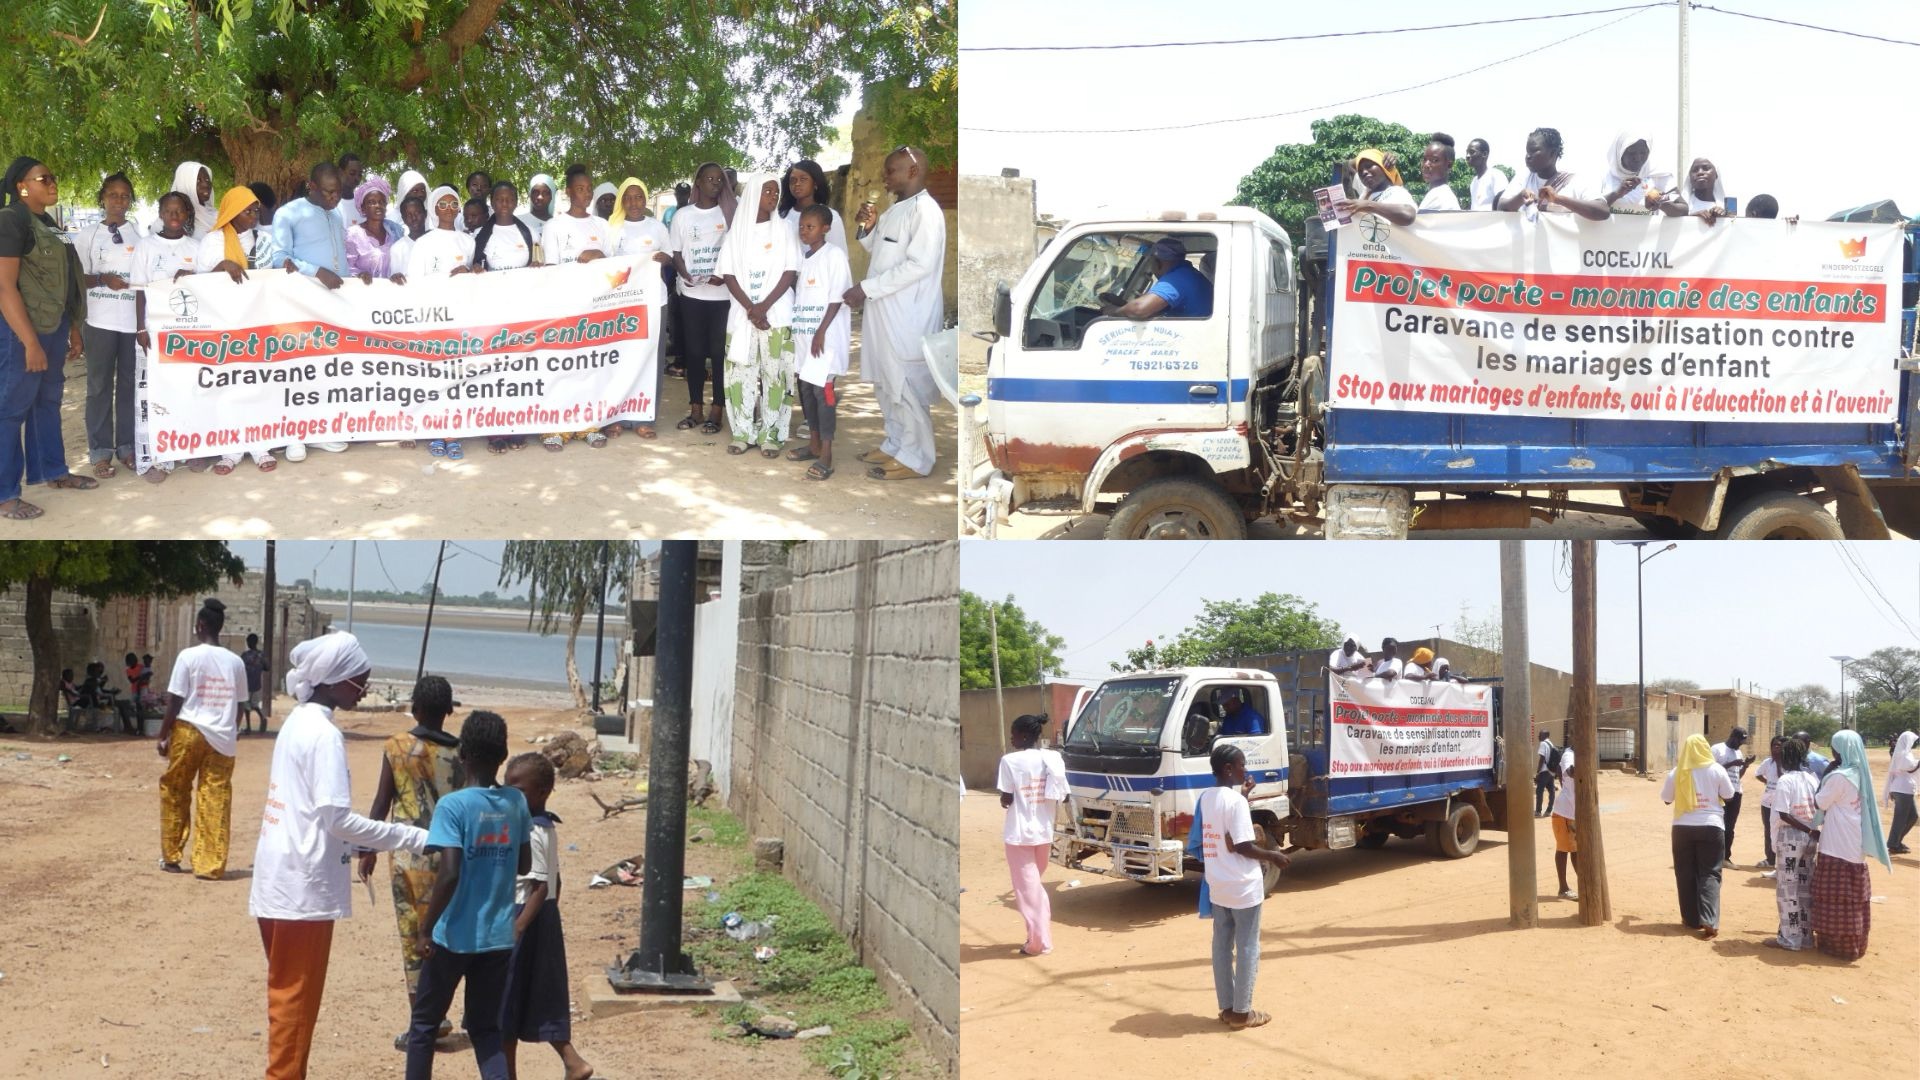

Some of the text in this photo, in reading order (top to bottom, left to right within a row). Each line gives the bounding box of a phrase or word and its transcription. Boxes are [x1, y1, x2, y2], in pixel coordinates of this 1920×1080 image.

[1347, 251, 1378, 259] Jeunesse
[1362, 242, 1386, 252] enda
[1583, 250, 1673, 269] COCEJ/KL
[1353, 266, 1452, 304] Projet
[1456, 278, 1544, 306] porte
[1570, 281, 1703, 309] monnaie
[1708, 283, 1761, 311] des
[1766, 286, 1877, 315] enfants
[371, 307, 454, 325] COCEJ/KL
[1385, 307, 1855, 348] Caravane de sensibilisation contre
[165, 333, 260, 365] Projet
[264, 325, 340, 362] porte
[364, 330, 484, 356] monnaie
[490, 328, 537, 350] des
[543, 312, 640, 344] enfants
[198, 349, 620, 389] Caravane de sensibilisation contre
[1477, 346, 1770, 381] les mariages d'enfant
[284, 378, 545, 407] les mariages d'enfant
[1337, 374, 1893, 414] Stop aux mariages d'enfants, oui à l'éducation et à l'avenir
[156, 392, 652, 454] Stop aux mariages d'enfants, oui à l'éducation et à l'avenir
[1347, 725, 1481, 740] Caravane de sensibilisation contre
[1379, 741, 1461, 756] les mariages d'enfant
[1332, 760, 1349, 775] Stop
[1350, 761, 1364, 772] aux
[1364, 759, 1393, 774] mariages
[1423, 756, 1433, 769] oui
